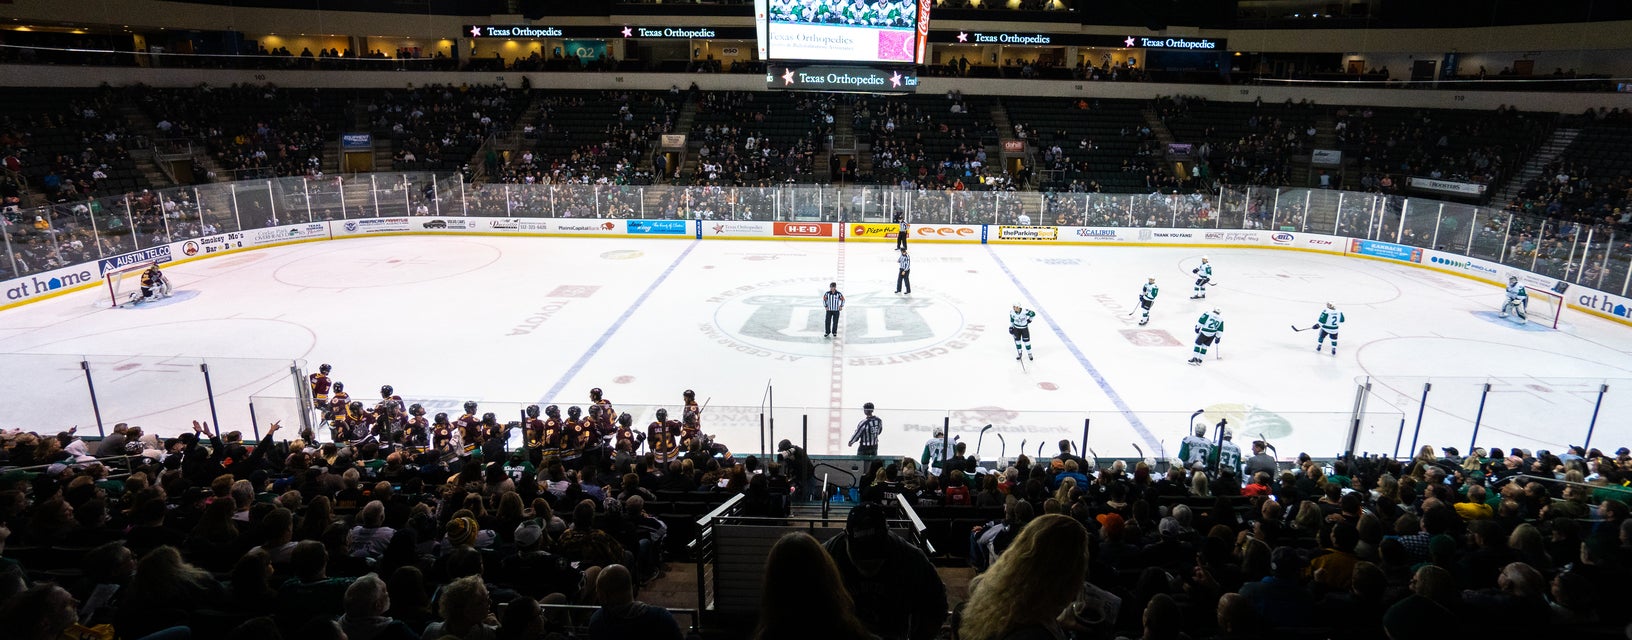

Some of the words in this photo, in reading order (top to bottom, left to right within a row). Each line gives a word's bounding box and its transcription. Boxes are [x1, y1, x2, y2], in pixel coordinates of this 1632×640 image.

[487, 27, 510, 36] Texas
[512, 27, 562, 37] Orthopedics
[639, 28, 662, 37] Texas
[664, 28, 715, 38] Orthopedics
[796, 32, 854, 45] Orthopedics
[975, 33, 997, 43] Texas
[1000, 33, 1050, 45] Orthopedics
[1142, 38, 1164, 47] Texas
[1166, 38, 1215, 49] Orthopedics
[576, 47, 594, 58] Q2
[800, 74, 824, 83] Texas
[827, 74, 884, 86] Orthopedics
[866, 226, 883, 234] Pizza
[1076, 229, 1115, 237] EXCALIBUR
[201, 236, 224, 245] Smokey
[117, 250, 145, 265] AUSTIN
[147, 246, 170, 258] TELCO
[7, 283, 29, 299] at
[1580, 295, 1598, 308] at
[504, 300, 570, 336] TOYOTA
[1332, 316, 1337, 325] 2
[849, 346, 949, 366] CENTER
[1199, 449, 1207, 466] 3
